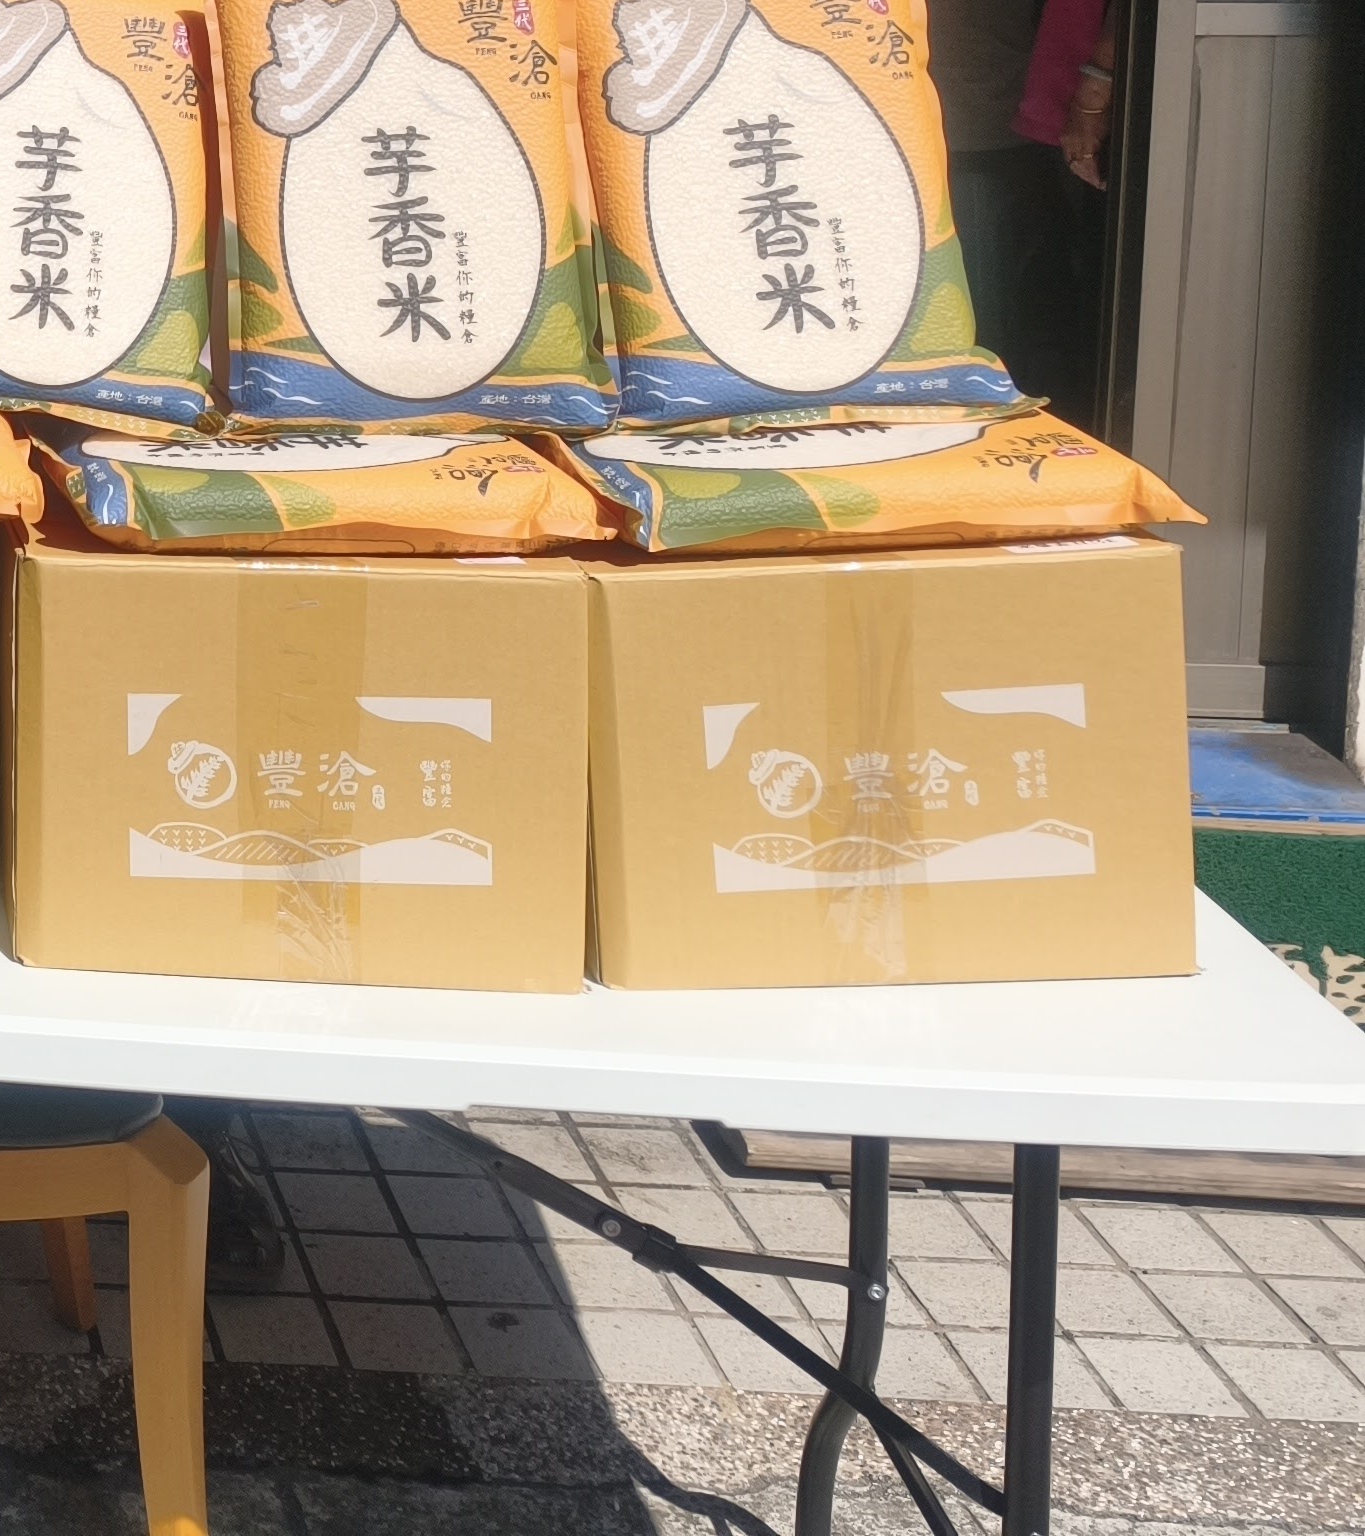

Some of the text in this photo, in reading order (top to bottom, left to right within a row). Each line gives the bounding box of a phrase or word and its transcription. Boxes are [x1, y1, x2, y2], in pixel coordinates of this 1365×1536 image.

[9, 125, 84, 331] 芋香米
[361, 125, 451, 343] 芋香米
[723, 114, 836, 334] 芋香米
[258, 750, 376, 797] 豐滄
[843, 748, 968, 801] 豐滄
